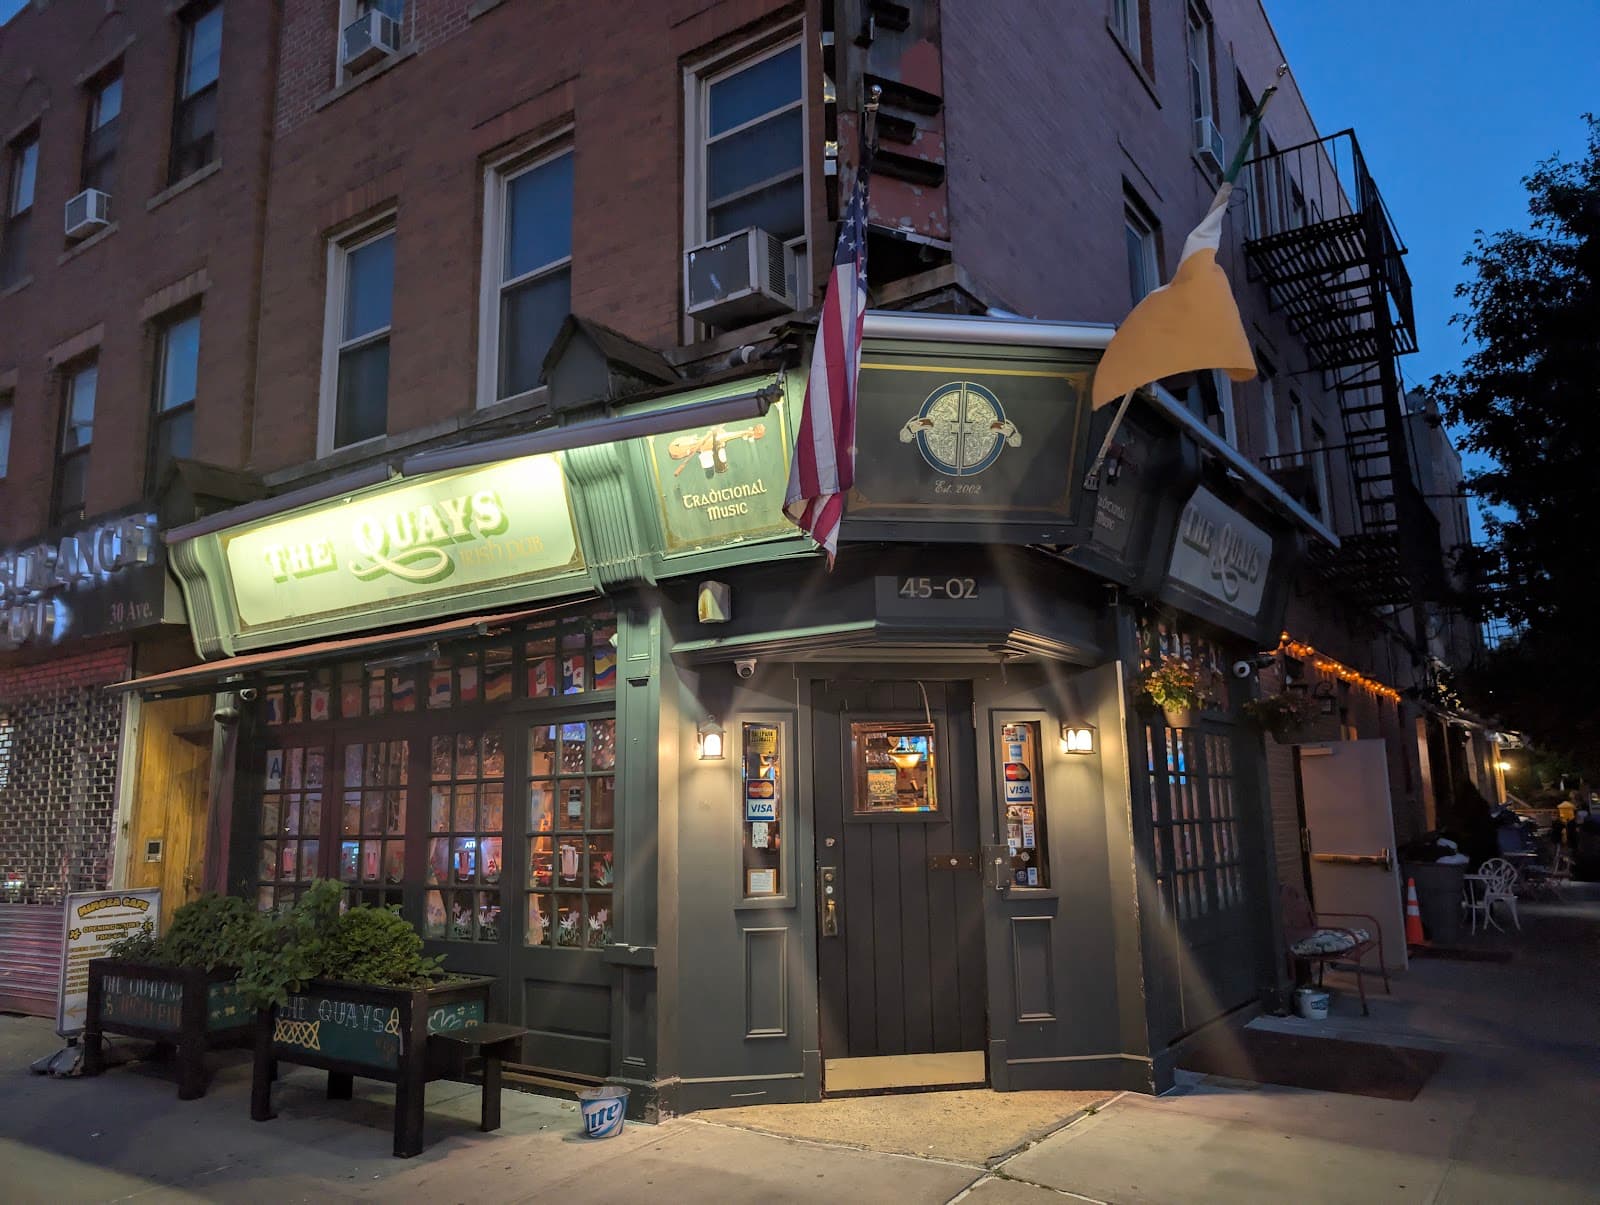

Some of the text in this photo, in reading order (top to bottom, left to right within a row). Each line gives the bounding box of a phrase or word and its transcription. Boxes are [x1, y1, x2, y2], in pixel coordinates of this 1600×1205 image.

[682, 478, 767, 509] TRADITIONAL
[707, 502, 749, 521] MUSIC
[263, 490, 510, 584] THE QUAYS
[1183, 501, 1259, 602] THE QUAYS
[899, 577, 979, 599] 45-02
[270, 757, 281, 779] A
[1009, 786, 1031, 794] VISA
[750, 803, 773, 813] VISA
[318, 999, 384, 1033] QUAYS
